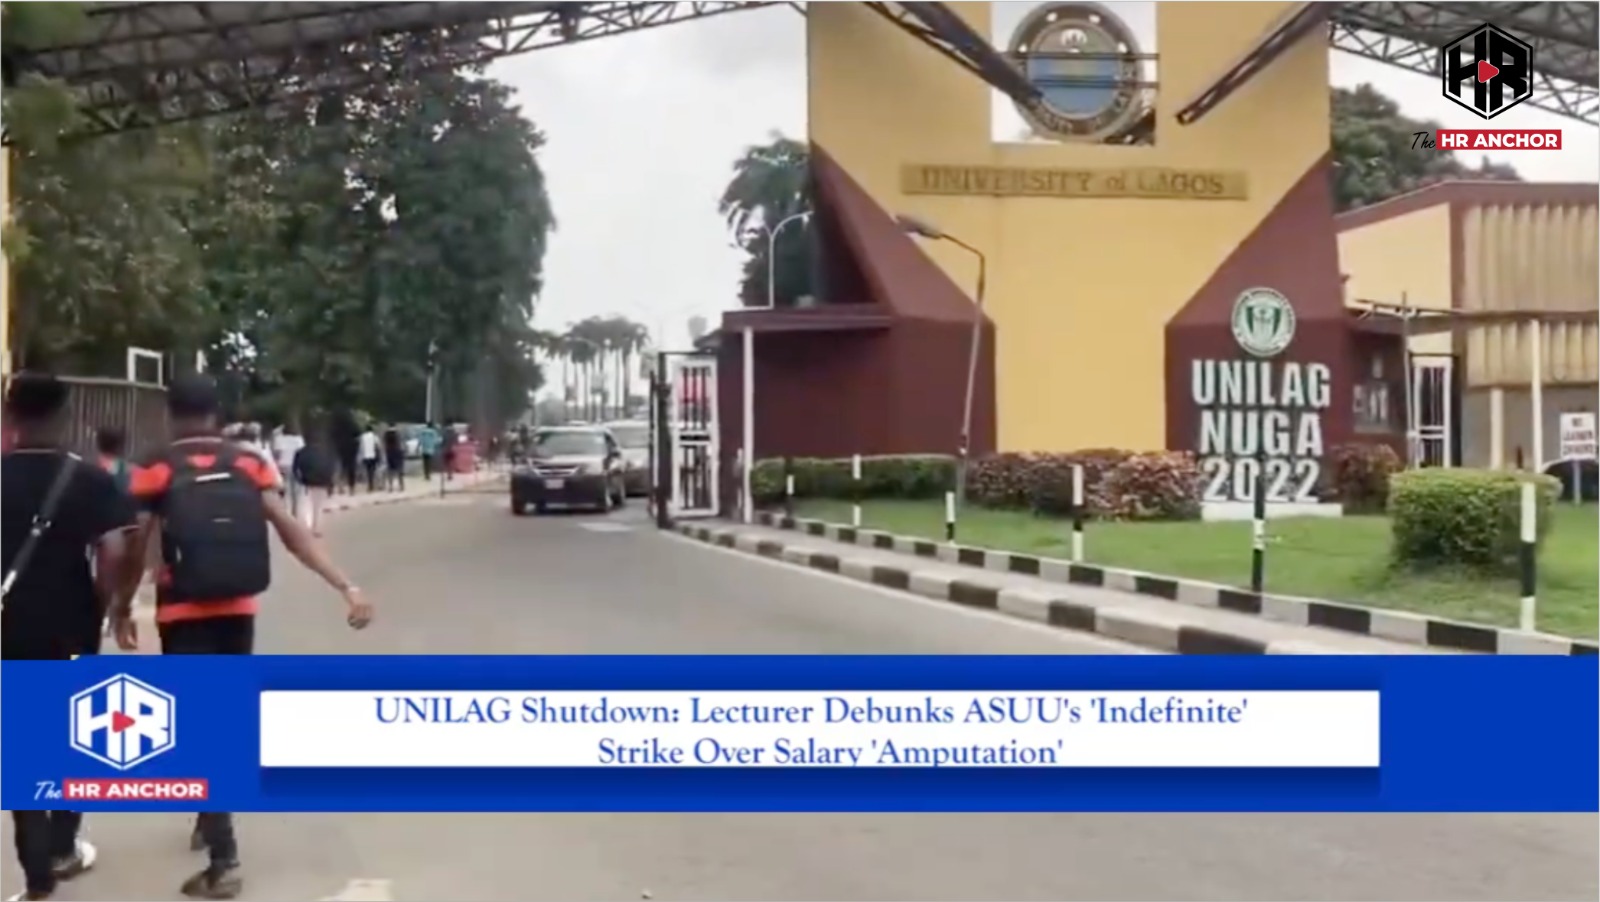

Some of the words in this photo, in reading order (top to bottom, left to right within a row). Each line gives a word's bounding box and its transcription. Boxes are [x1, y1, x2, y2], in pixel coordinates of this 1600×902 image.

[1192, 359, 1331, 408] UNILAG
[1200, 410, 1324, 457] NUGA
[1202, 457, 1320, 503] 2022
